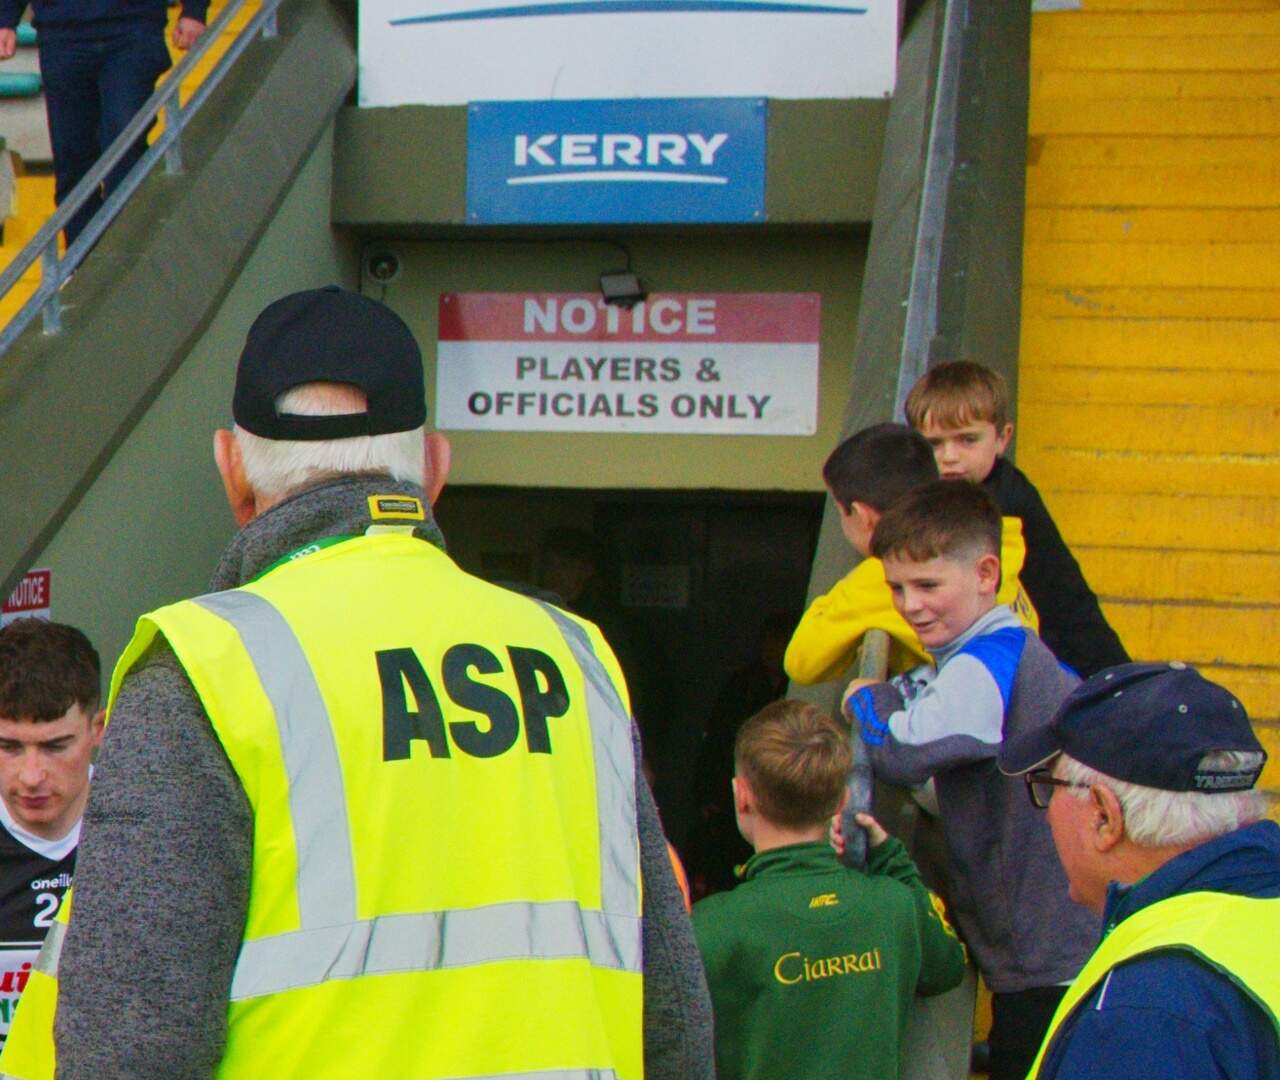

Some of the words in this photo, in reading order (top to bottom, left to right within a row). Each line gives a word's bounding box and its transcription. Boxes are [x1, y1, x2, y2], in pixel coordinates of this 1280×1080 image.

[513, 133, 730, 166] KERRY
[523, 298, 717, 334] NOTICE
[515, 356, 681, 382] PLAYERS
[695, 357, 721, 383] &
[468, 391, 659, 418] OFFICIALS
[670, 394, 772, 419] ONLY
[374, 642, 571, 762] ASP
[33, 892, 66, 928] 2
